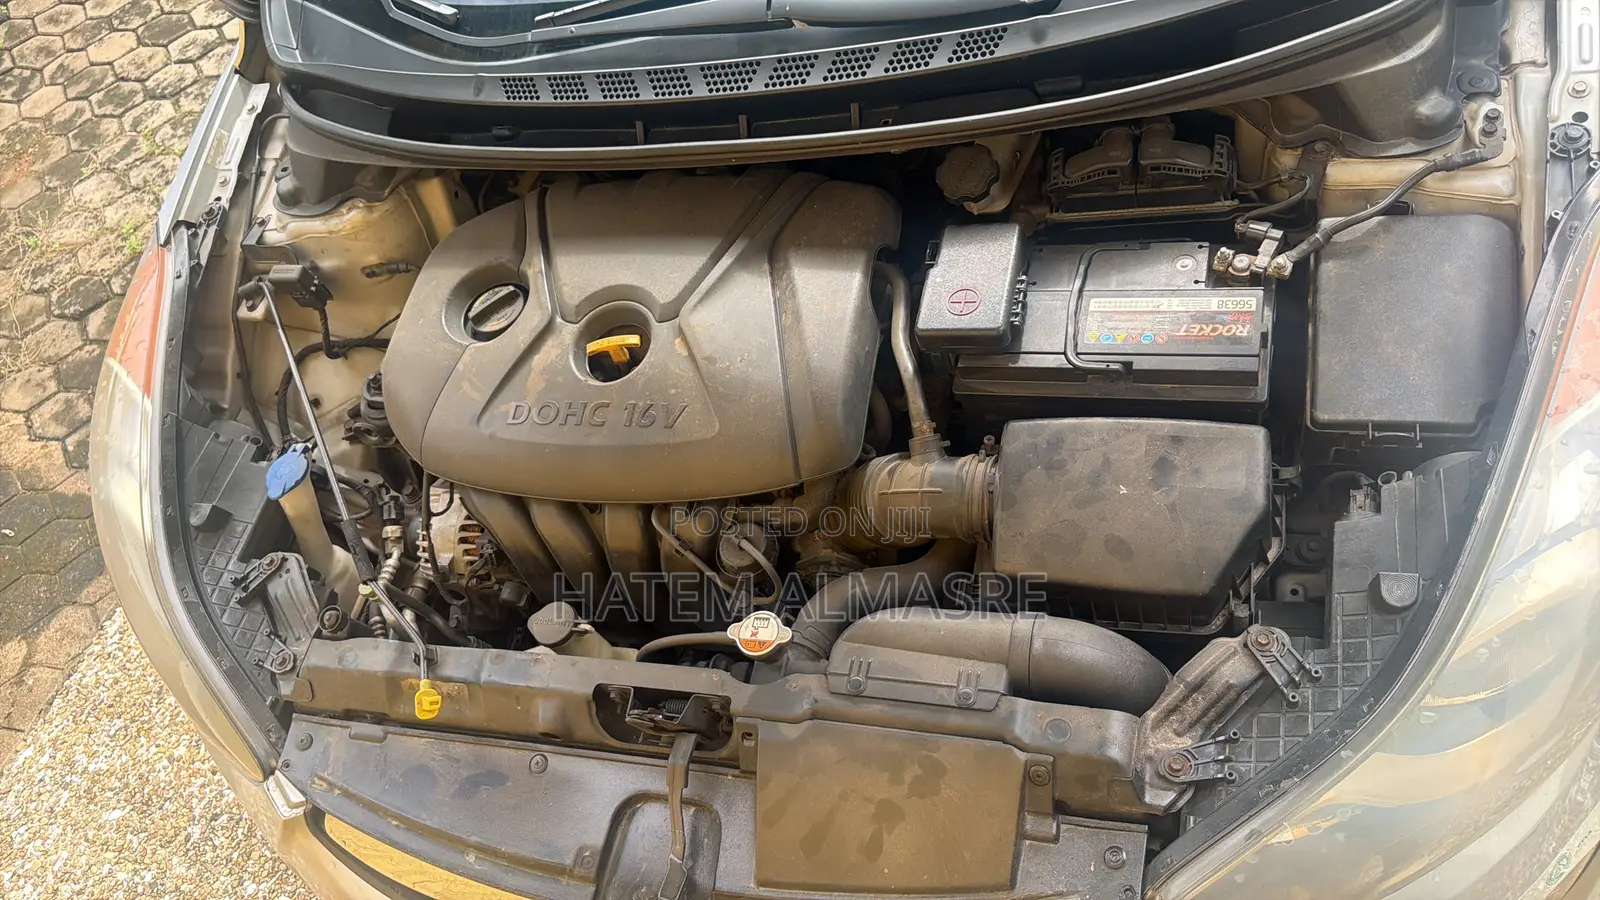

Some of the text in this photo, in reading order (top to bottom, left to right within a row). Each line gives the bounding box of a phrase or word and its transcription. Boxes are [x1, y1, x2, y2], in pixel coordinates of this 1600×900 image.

[1217, 299, 1253, 309] 56638
[1176, 323, 1251, 336] ROCKET
[506, 400, 688, 428] DOHC 16V
